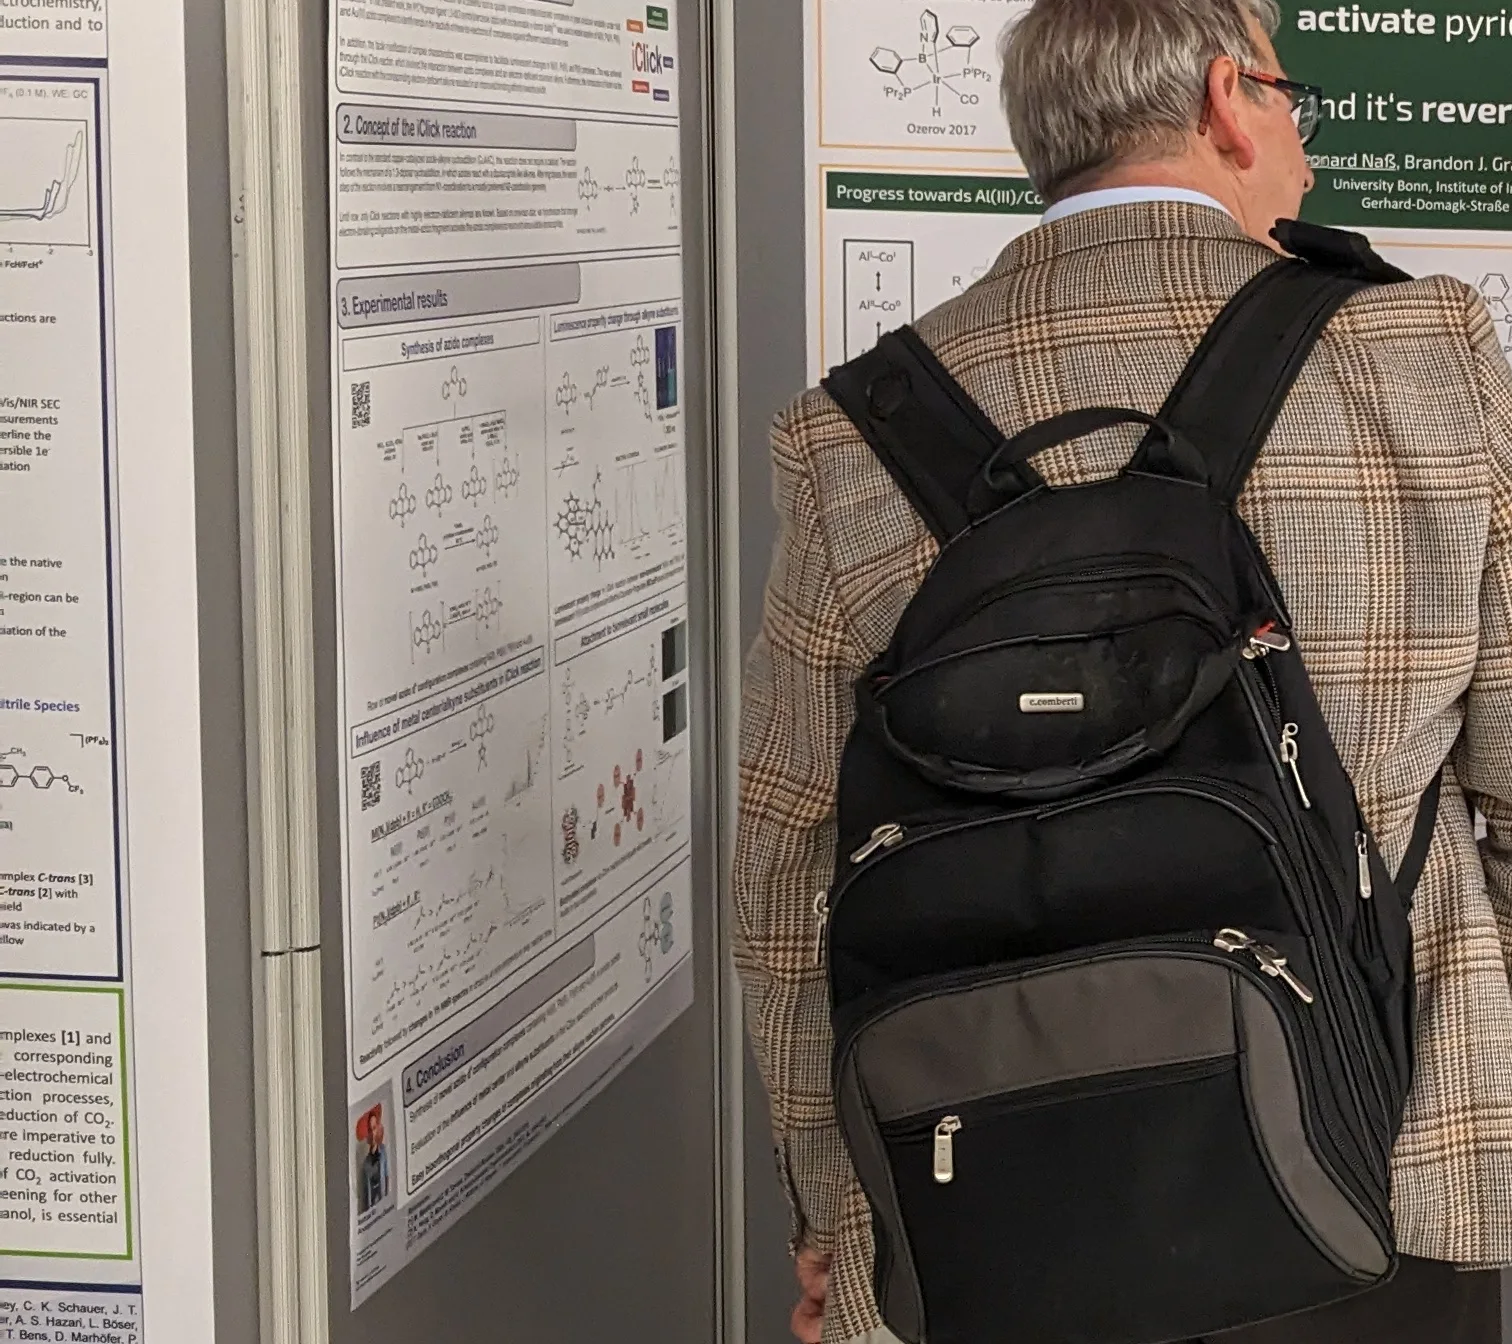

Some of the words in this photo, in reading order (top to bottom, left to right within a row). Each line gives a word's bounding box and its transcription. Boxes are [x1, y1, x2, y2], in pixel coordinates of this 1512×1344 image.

[1297, 4, 1436, 36] activate
[631, 41, 663, 75] iClick
[1315, 92, 1357, 122] nd
[343, 115, 354, 135] 2.
[356, 115, 391, 140] Concept
[391, 117, 399, 137] of
[400, 118, 415, 138] the
[416, 118, 441, 139] iClick
[442, 121, 477, 139] reaction
[907, 123, 946, 136] Ozerov
[949, 124, 977, 137] 2017
[1361, 153, 1400, 172] Naß,
[1405, 155, 1474, 172] Brandon
[1478, 156, 1489, 172] J.
[836, 184, 905, 203] Progress
[908, 188, 972, 203] towards
[1333, 178, 1394, 194] University
[1397, 179, 1432, 195] Bonn,
[1435, 180, 1487, 195] Institute
[1490, 181, 1504, 196] of
[1361, 196, 1510, 214] Gerhard-Domagk-Straße
[341, 296, 351, 317] 3.
[352, 290, 416, 319] Experimental
[417, 288, 449, 307] results
[14, 1051, 113, 1068] corresponding
[415, 1042, 466, 1088] Conclusion
[42, 1092, 114, 1107] processes,
[64, 1110, 79, 1124] of
[22, 1129, 96, 1145] imperative
[101, 1133, 116, 1145] to
[9, 1148, 75, 1163] reduction
[82, 1150, 116, 1167] fully.
[49, 1170, 117, 1185] activation
[53, 1189, 73, 1203] for
[79, 1191, 118, 1205] other
[57, 1211, 118, 1224] essential
